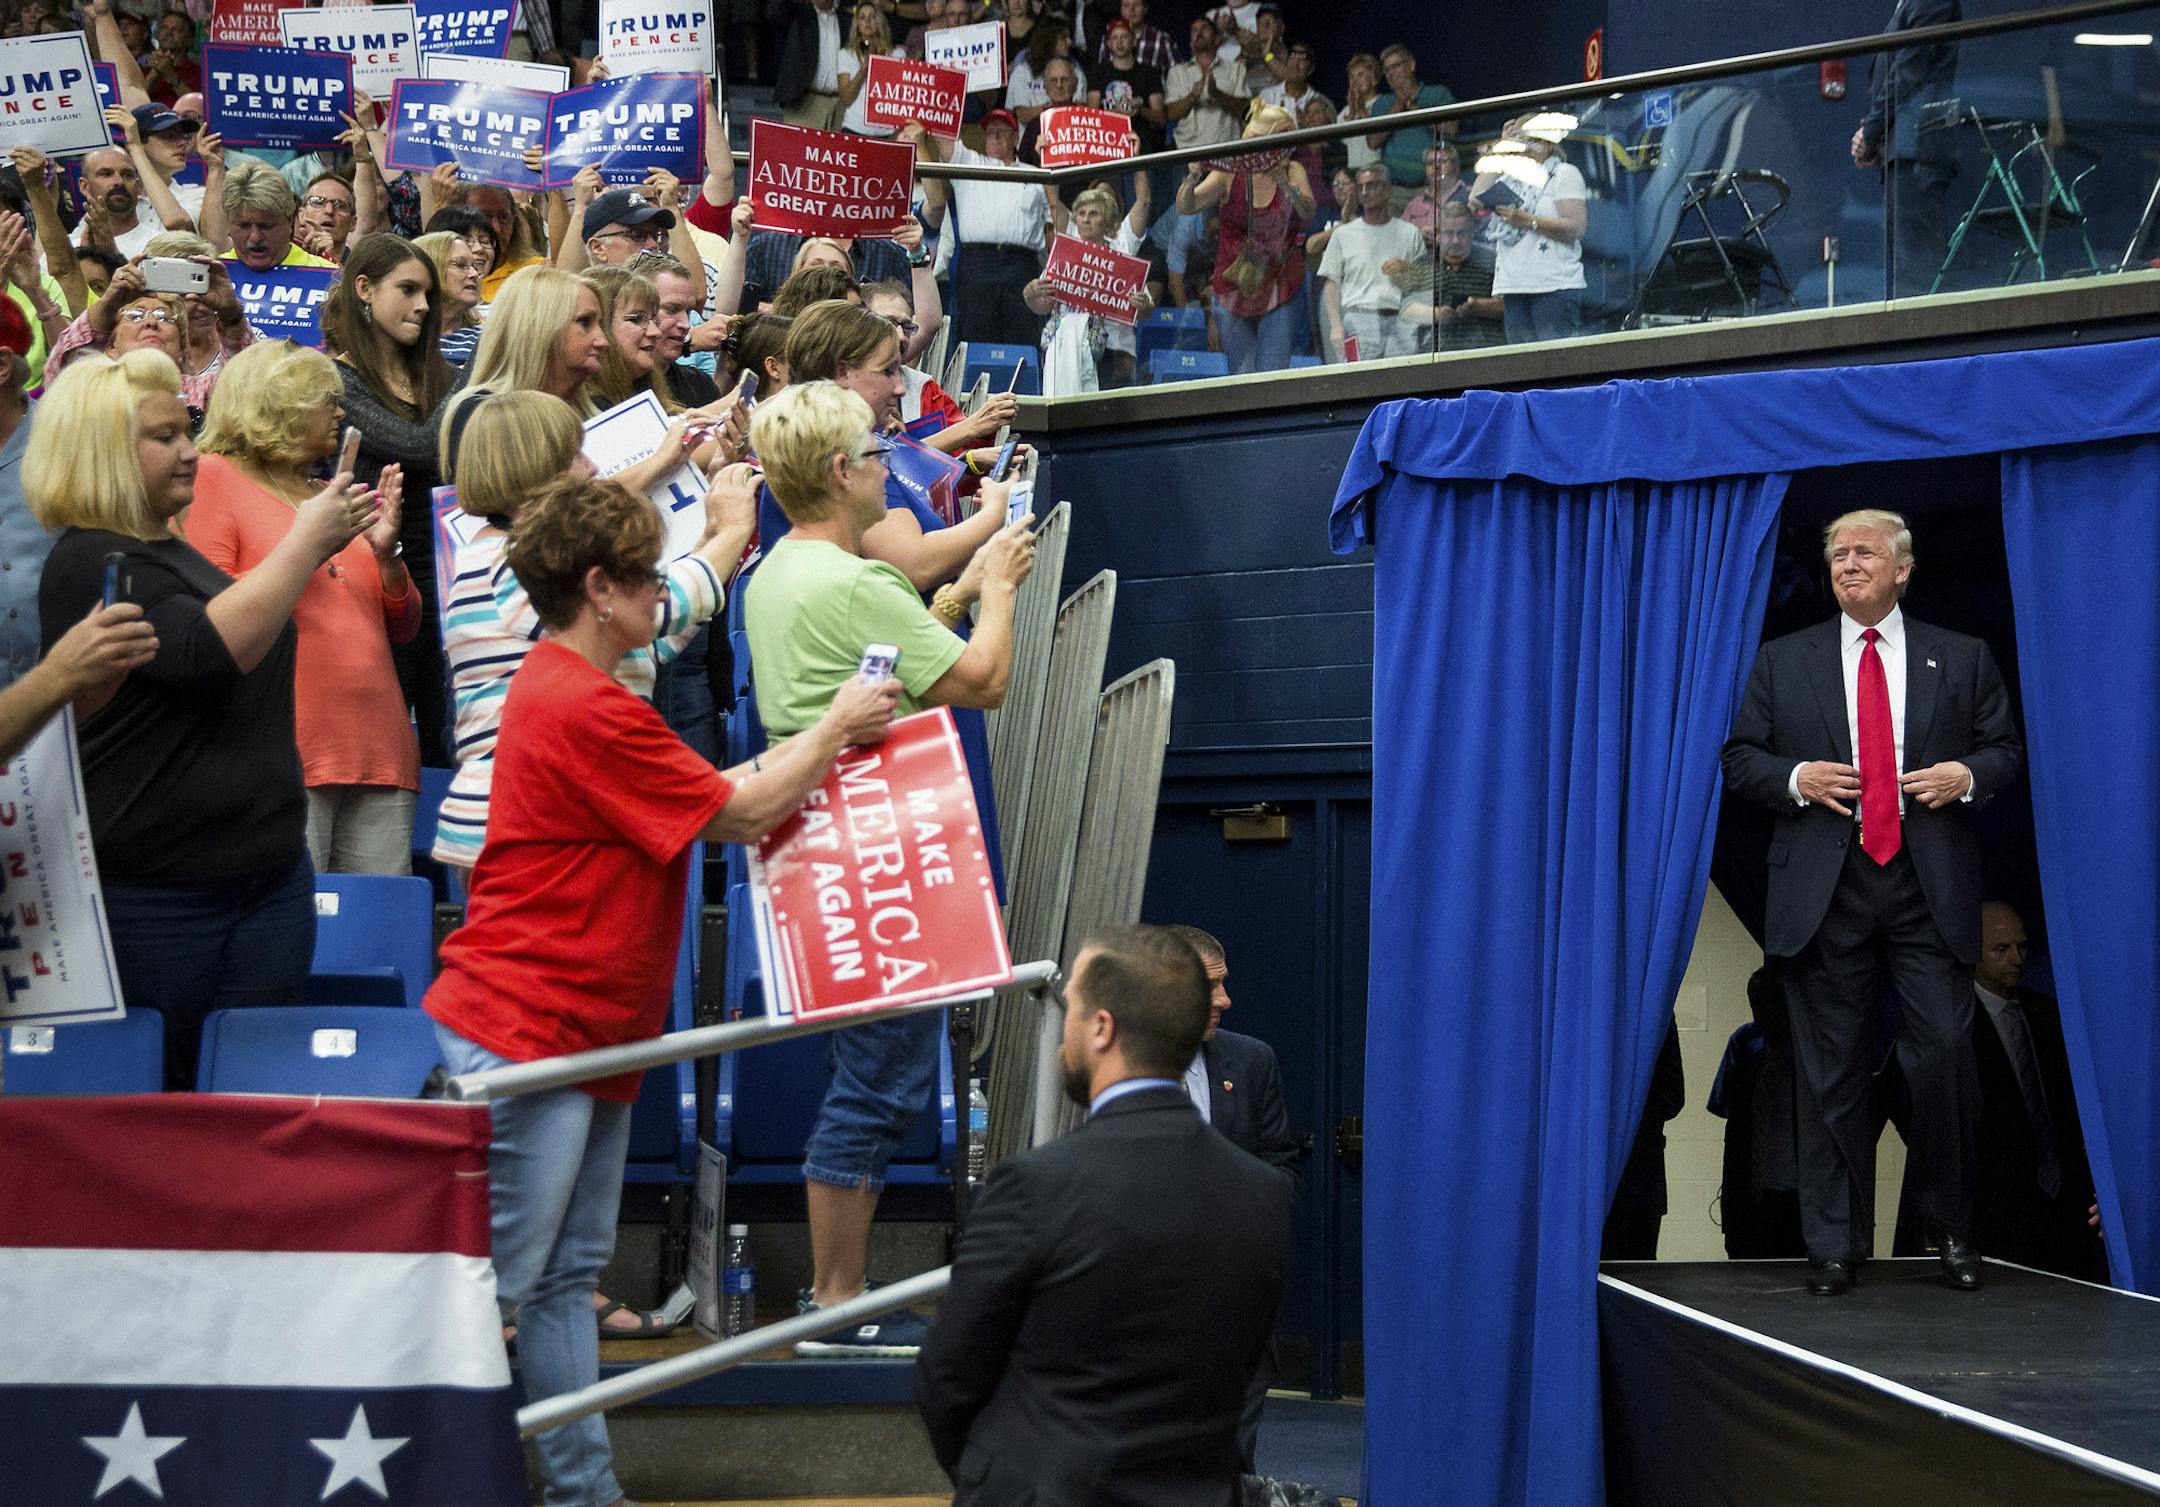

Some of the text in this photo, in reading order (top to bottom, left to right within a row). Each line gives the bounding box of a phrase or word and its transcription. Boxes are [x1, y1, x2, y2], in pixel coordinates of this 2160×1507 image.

[243, 2, 275, 13] MAKE
[214, 14, 281, 30] AMERI
[416, 9, 509, 31] TRUMP
[606, 12, 706, 35] TRUMP
[219, 30, 283, 42] GREAT AGA
[292, 33, 410, 51] TRUMP
[418, 26, 496, 42] PENCE
[612, 32, 699, 48] PENCE
[931, 41, 995, 59] TRUMP
[937, 57, 990, 69] ENCE
[0, 68, 83, 97] UMP
[212, 72, 345, 97] TRUMP
[902, 70, 936, 85] MAKE
[5, 95, 74, 114] NCE
[225, 94, 332, 112] PENCE
[869, 81, 961, 113] AMERICA
[20, 117, 48, 126] GREAT
[51, 112, 82, 122] AGAIN!
[221, 110, 336, 123] MAKE AMERICA GREAT AGAIN!
[403, 103, 542, 135] TRUMP
[555, 103, 694, 132] TRUMP
[875, 101, 954, 125] GREAT AGAIN
[1070, 115, 1102, 128] MAKE
[412, 121, 526, 149] PENCE
[565, 127, 680, 144] PENCE
[1046, 126, 1130, 148] AMERICA
[407, 136, 526, 161] MAKE AMERICA GREAT AGAIN
[585, 144, 623, 153] AMERICA
[625, 144, 652, 152] GREAT
[805, 146, 858, 168] MAKE
[1049, 143, 1125, 158] GREAT AGAIN
[610, 174, 637, 182] 2016
[754, 159, 907, 200] AMERICA
[764, 191, 896, 220] GREAT AGAIN
[1081, 252, 1116, 272] MAKE
[1047, 259, 1138, 298] AMERICA
[232, 281, 330, 306] UMP
[1091, 290, 1130, 311] AGAIN
[243, 302, 312, 319] NCE
[252, 317, 313, 328] GREAT AGAIN!
[623, 446, 655, 467] MAKE
[25, 803, 42, 855] GREAT
[904, 787, 955, 889] MAKE
[77, 831, 93, 879] 2016
[834, 746, 929, 995] MERICA
[800, 788, 866, 982] EAT AGAIN
[36, 861, 59, 932] AMERICA
[53, 939, 69, 982] MAKE
[28, 1032, 37, 1047] 3
